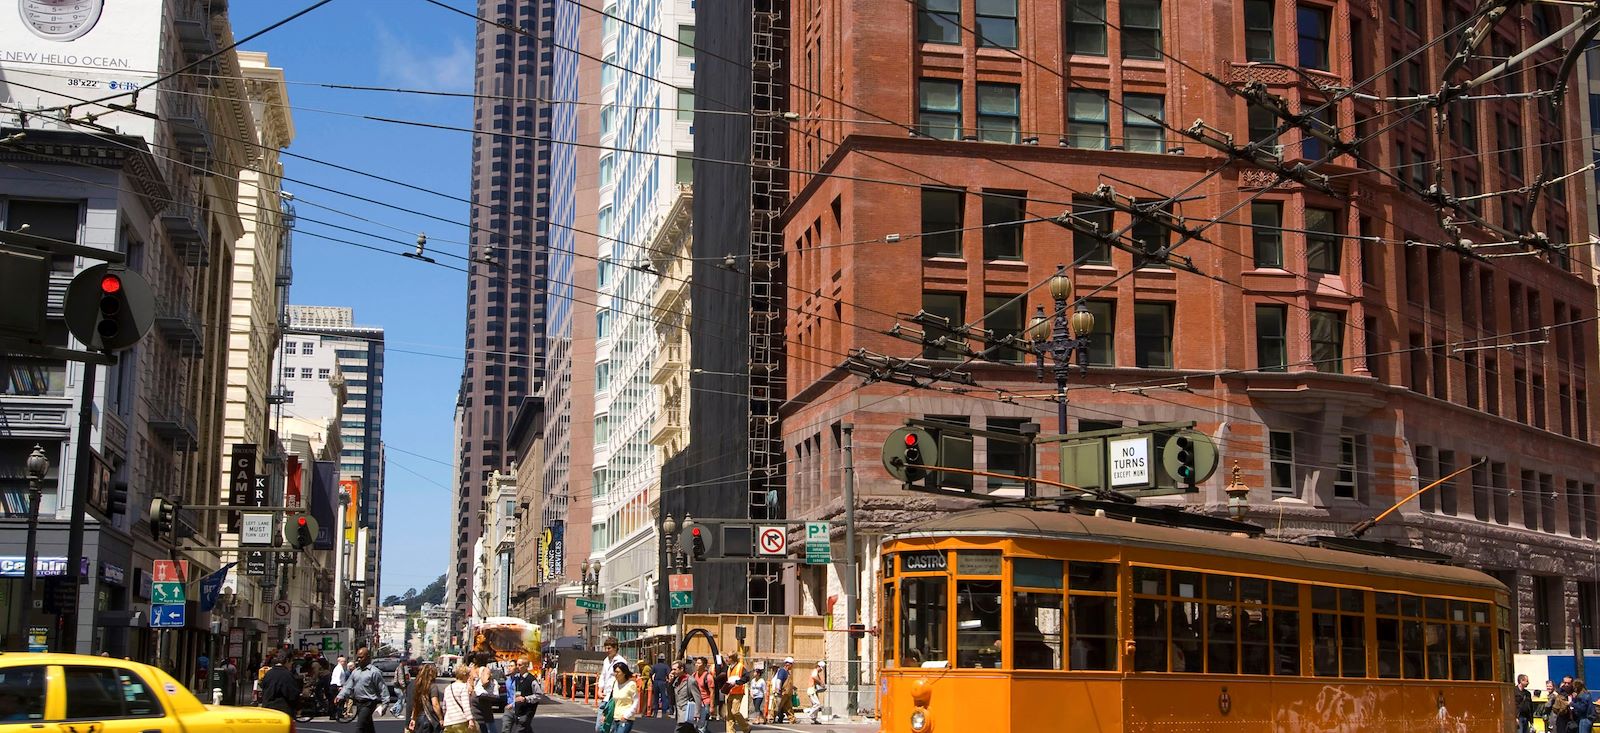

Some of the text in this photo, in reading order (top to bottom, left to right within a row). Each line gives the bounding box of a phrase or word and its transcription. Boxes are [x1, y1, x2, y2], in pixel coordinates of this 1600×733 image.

[6, 51, 131, 68] NEW HELIO OCEAN.
[119, 82, 139, 91] CBS
[1122, 446, 1135, 457] NO
[1113, 457, 1145, 469] TURNS
[1113, 471, 1131, 479] EXCEPT
[809, 525, 819, 538] P
[554, 541, 562, 575] SERVICES
[907, 554, 946, 569] CASTRO
[300, 637, 343, 650] FedEx
